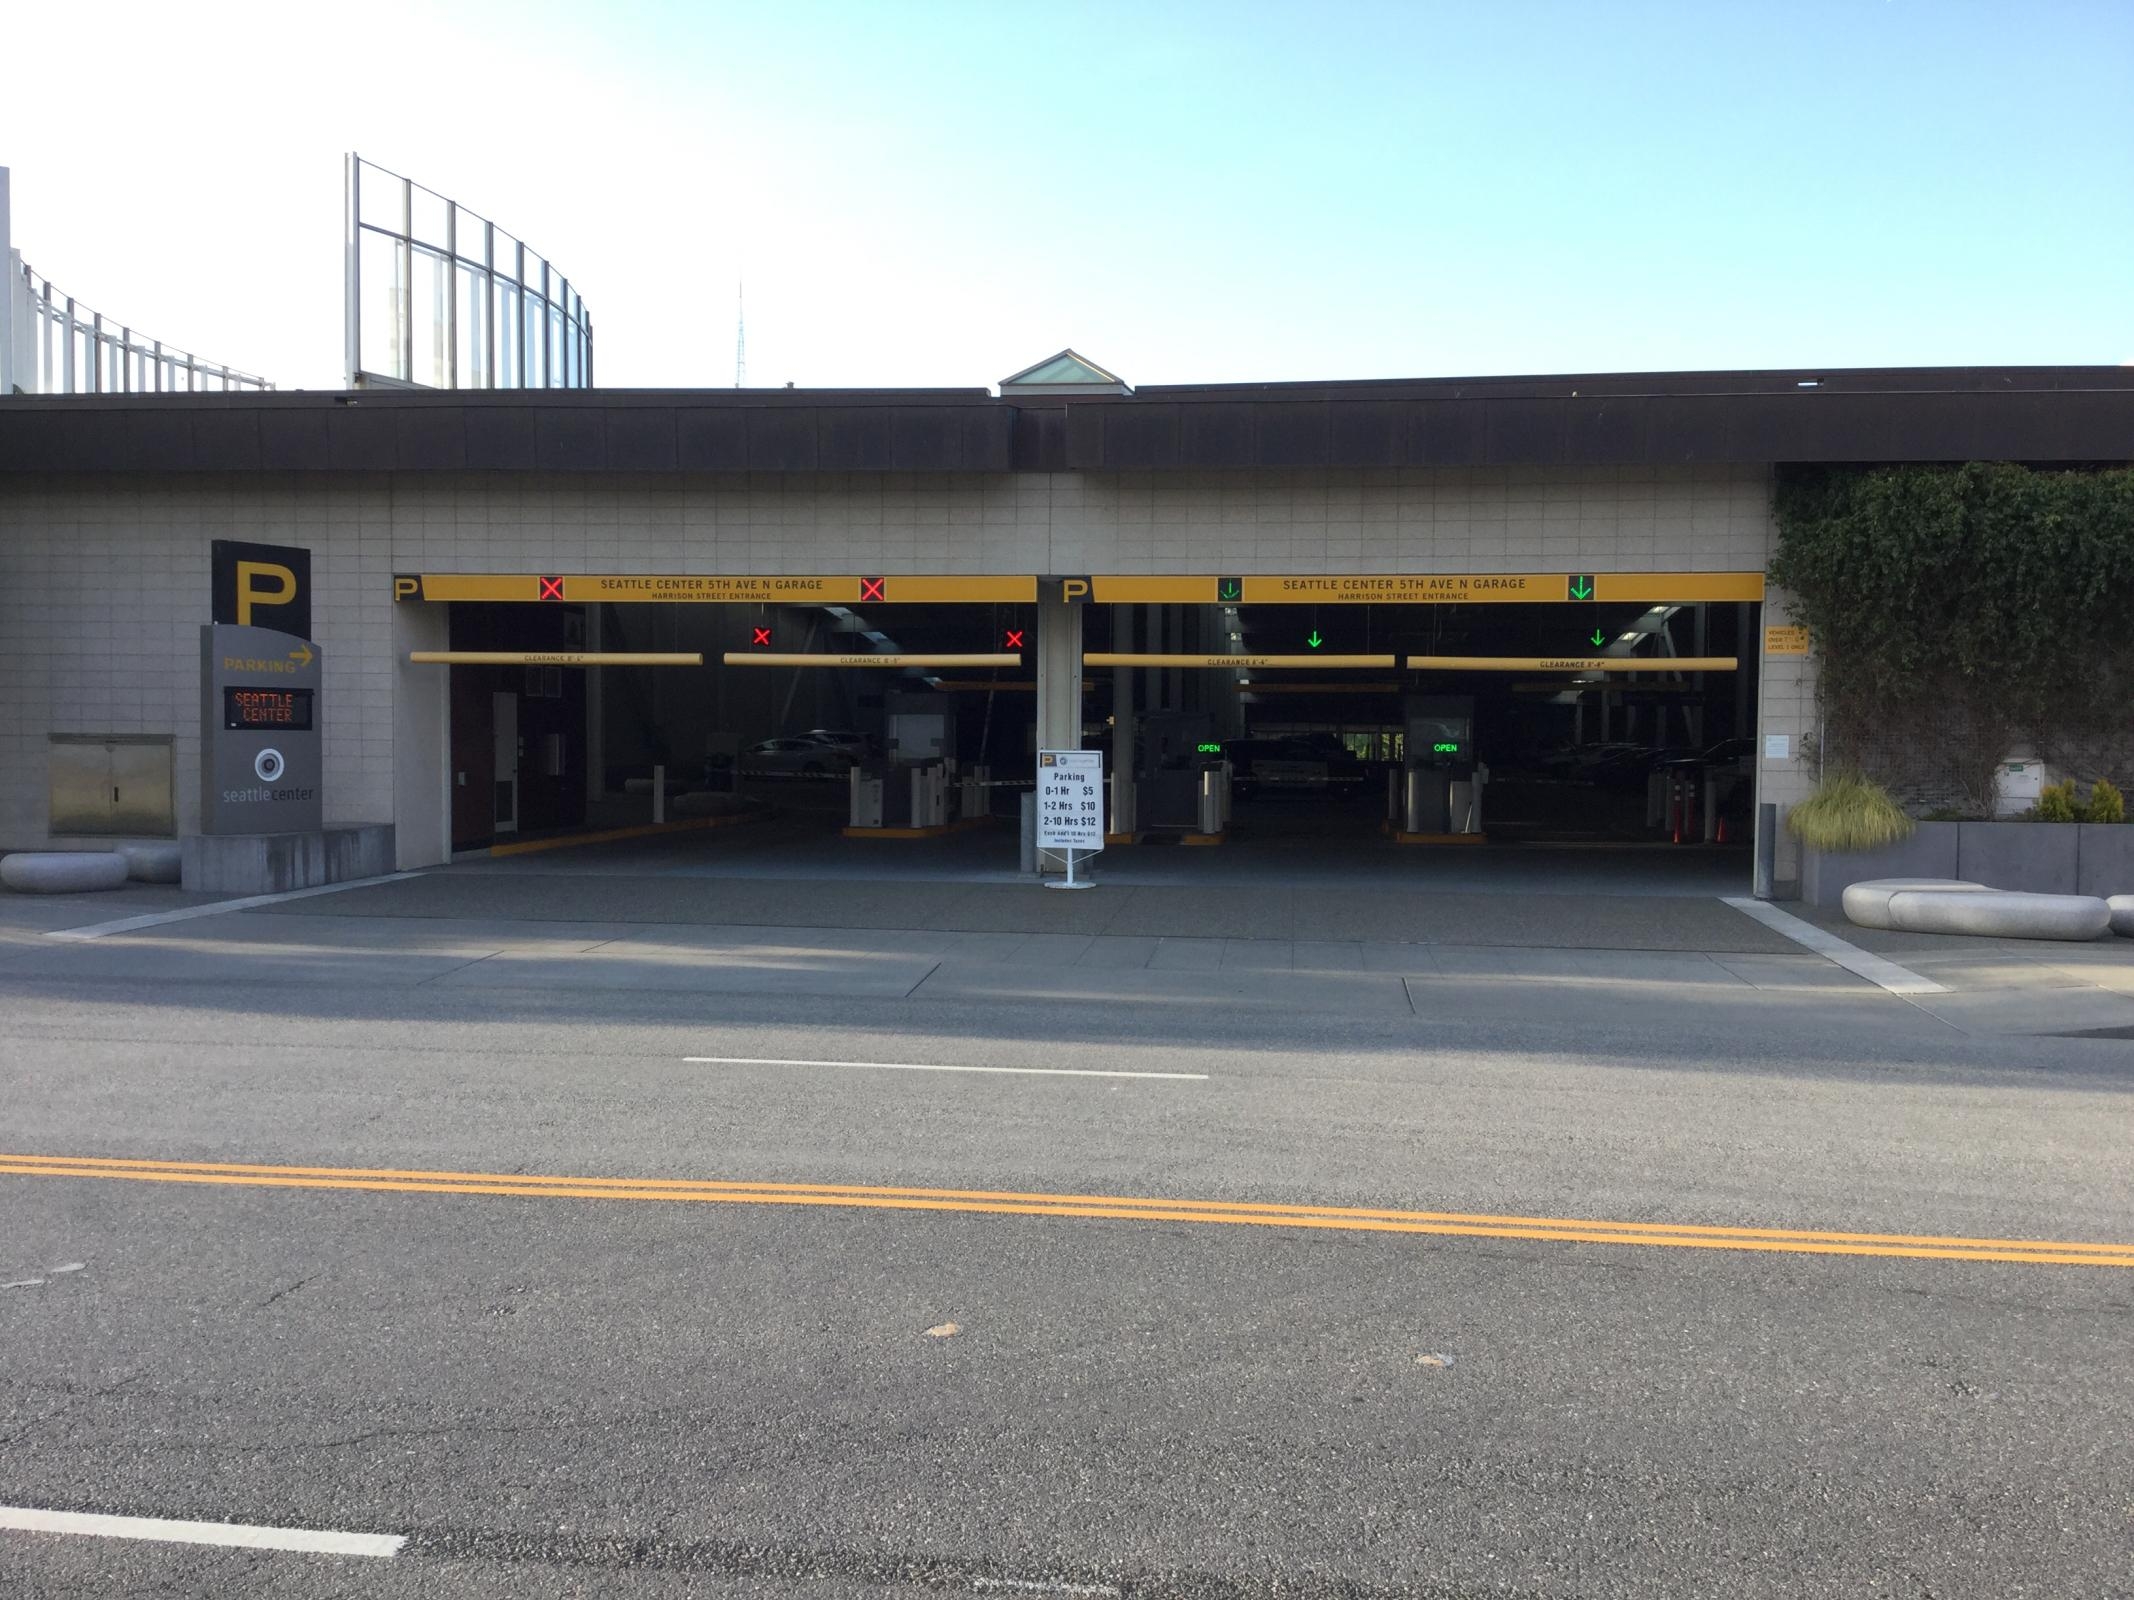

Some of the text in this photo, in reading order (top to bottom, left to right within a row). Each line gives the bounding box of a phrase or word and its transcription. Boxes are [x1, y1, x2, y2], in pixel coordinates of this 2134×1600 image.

[394, 578, 419, 601] P
[600, 579, 824, 590] SEATTLE CENTER 5TH AVE N GARAGE
[1283, 578, 1526, 590] SEATTLE CENTER 5TH AVE N GARAGE
[236, 560, 297, 627] P
[652, 592, 772, 600] HARRISON STREET ENTRANCE
[1063, 580, 1088, 602] P
[1338, 592, 1469, 600] HARRISON STREET ENTRANCE
[223, 656, 296, 673] PARKING
[1207, 659, 1250, 667] CLEARANCE
[1539, 661, 1585, 669] CLEARANCE
[234, 692, 293, 708] SEATTLE
[243, 707, 292, 722] CENTER
[1197, 744, 1221, 753] OPEN
[1434, 743, 1458, 752] OPEN
[1053, 772, 1085, 783] Parking
[1045, 785, 1094, 796] 0-1 Hr $5
[1044, 801, 1096, 812] 1-2 Hrs $10
[1043, 816, 1096, 827] 2-10 Hrs $12
